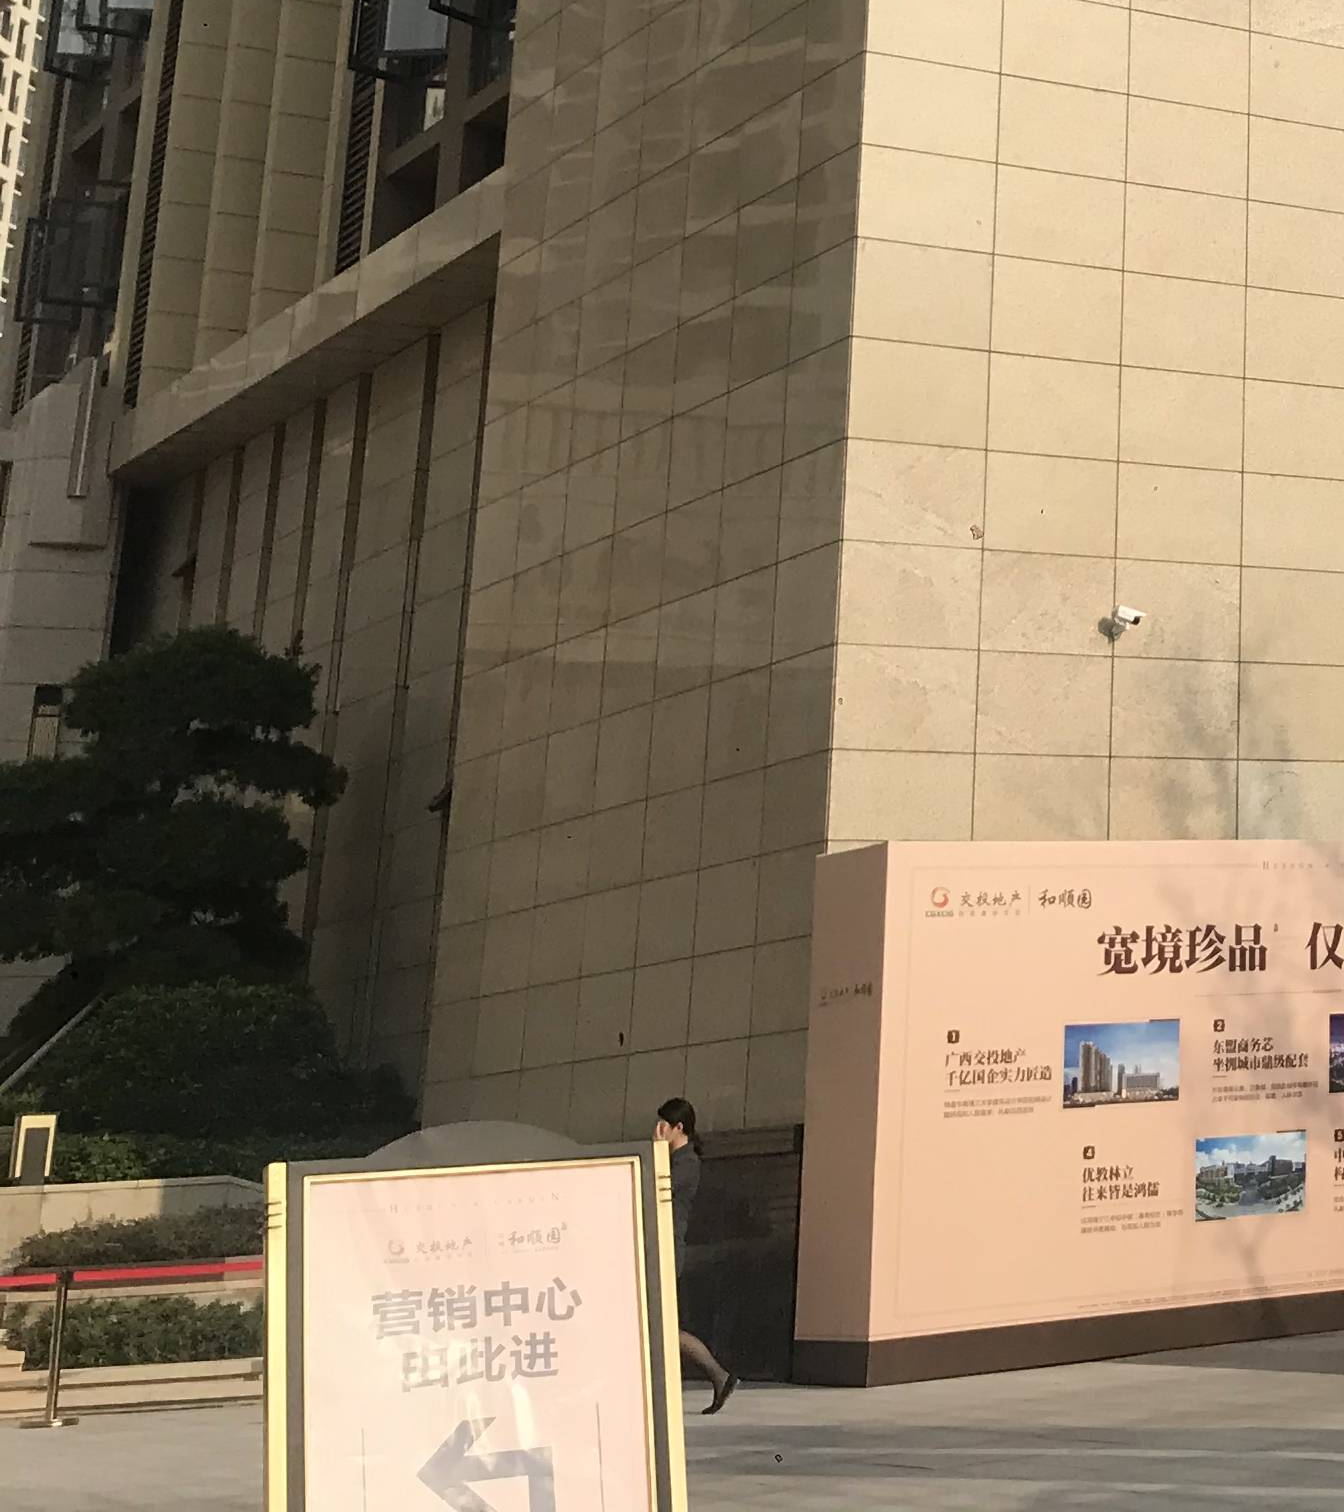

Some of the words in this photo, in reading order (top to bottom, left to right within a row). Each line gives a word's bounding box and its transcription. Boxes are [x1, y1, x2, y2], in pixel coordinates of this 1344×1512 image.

[1096, 922, 1268, 976] 宽境珍品
[945, 1048, 1026, 1067] 广西交投地产
[946, 1065, 1052, 1087] 千亿国企实力匠造
[1083, 1165, 1134, 1183] 优教林立
[371, 1277, 583, 1340] 营销中心
